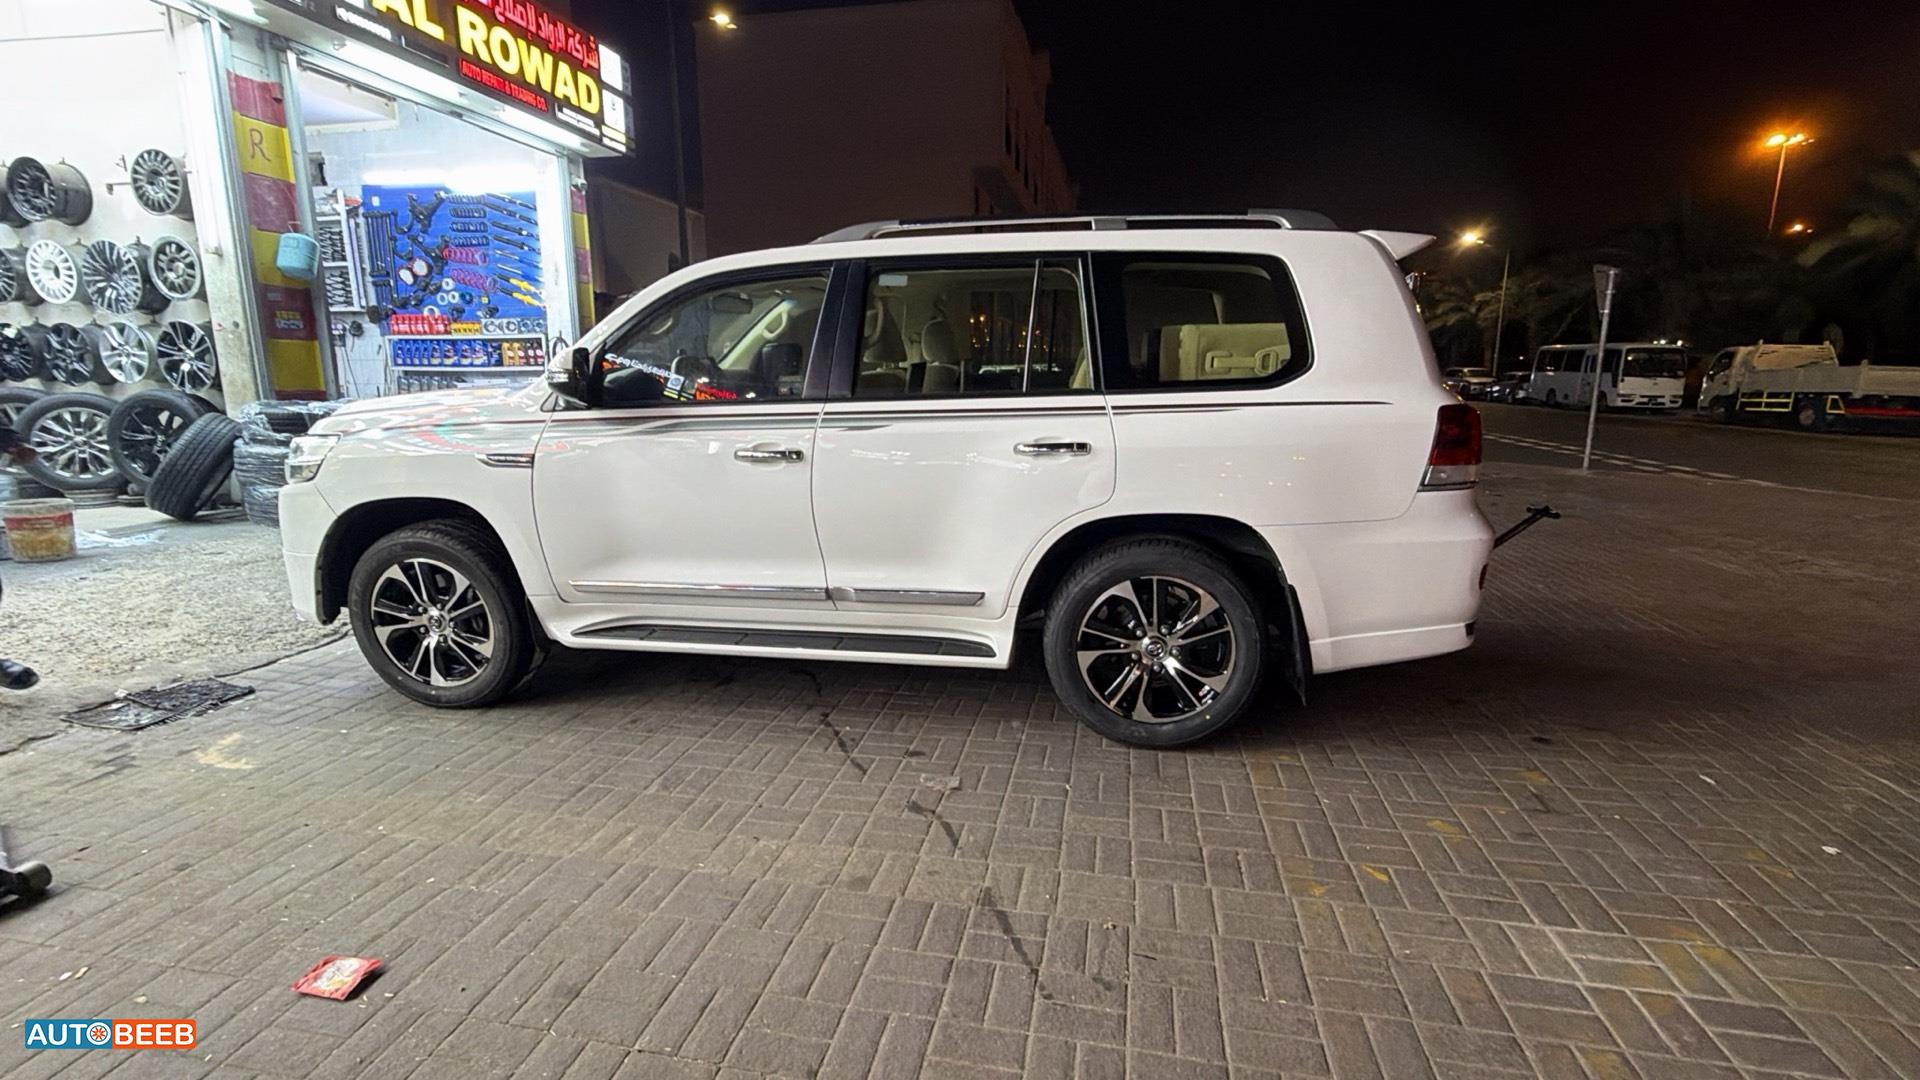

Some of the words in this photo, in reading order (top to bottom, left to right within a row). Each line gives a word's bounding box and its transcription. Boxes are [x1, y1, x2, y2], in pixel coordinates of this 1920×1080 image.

[538, 12, 566, 53] الرواد
[567, 27, 599, 69] شركة
[456, 4, 600, 114] ROWAD
[462, 60, 481, 82] AUTO
[249, 127, 271, 162] R
